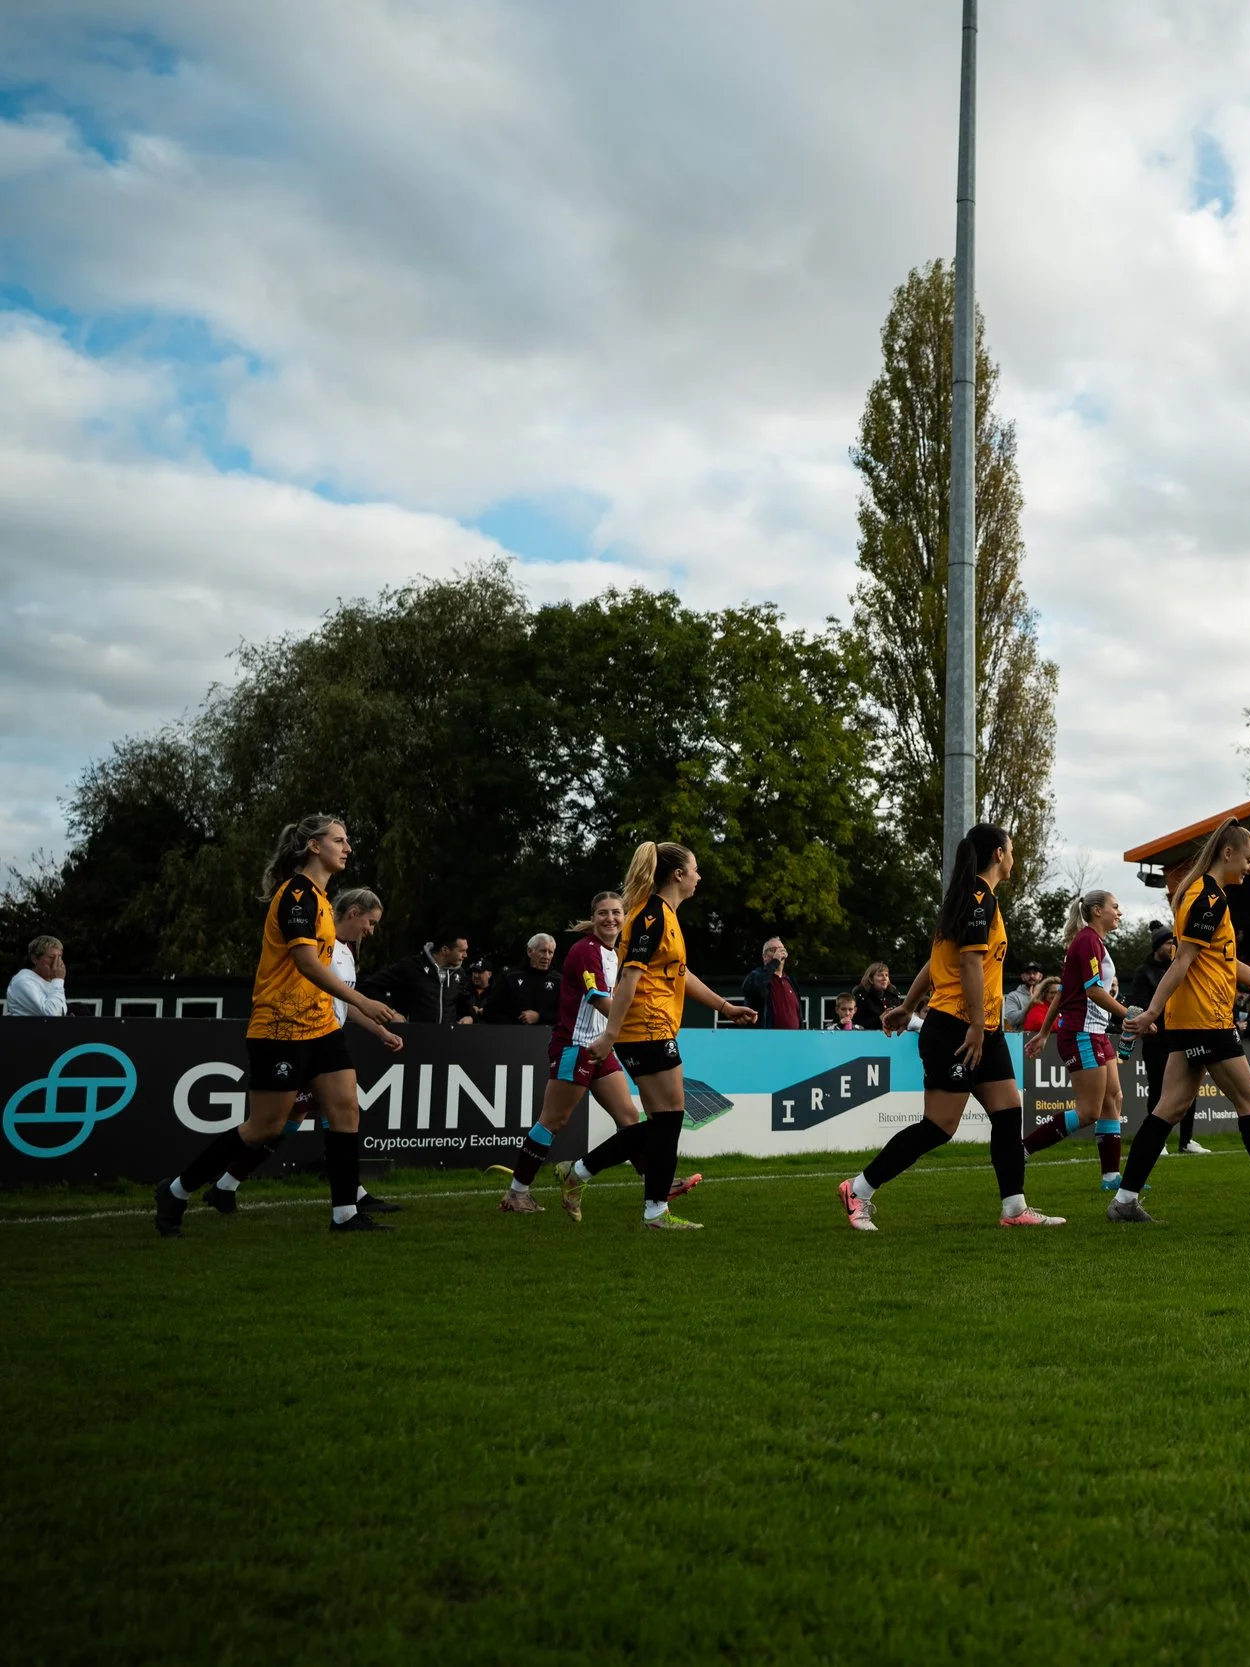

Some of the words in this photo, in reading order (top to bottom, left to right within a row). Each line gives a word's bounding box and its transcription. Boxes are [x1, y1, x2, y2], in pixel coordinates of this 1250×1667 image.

[1185, 1045, 1206, 1059] PJH
[1035, 1058, 1073, 1088] Lu
[173, 1061, 534, 1135] GMINI
[782, 1064, 879, 1123] IREN
[1136, 1082, 1149, 1098] ho
[1198, 1083, 1217, 1097] ate
[1035, 1099, 1065, 1110] Bitcoin
[1066, 1099, 1076, 1110] Mi
[878, 1112, 907, 1123] Bitcoin
[1035, 1114, 1054, 1125] Soft
[363, 1136, 467, 1151] Cryptocurrency
[470, 1134, 527, 1148] Exchang
